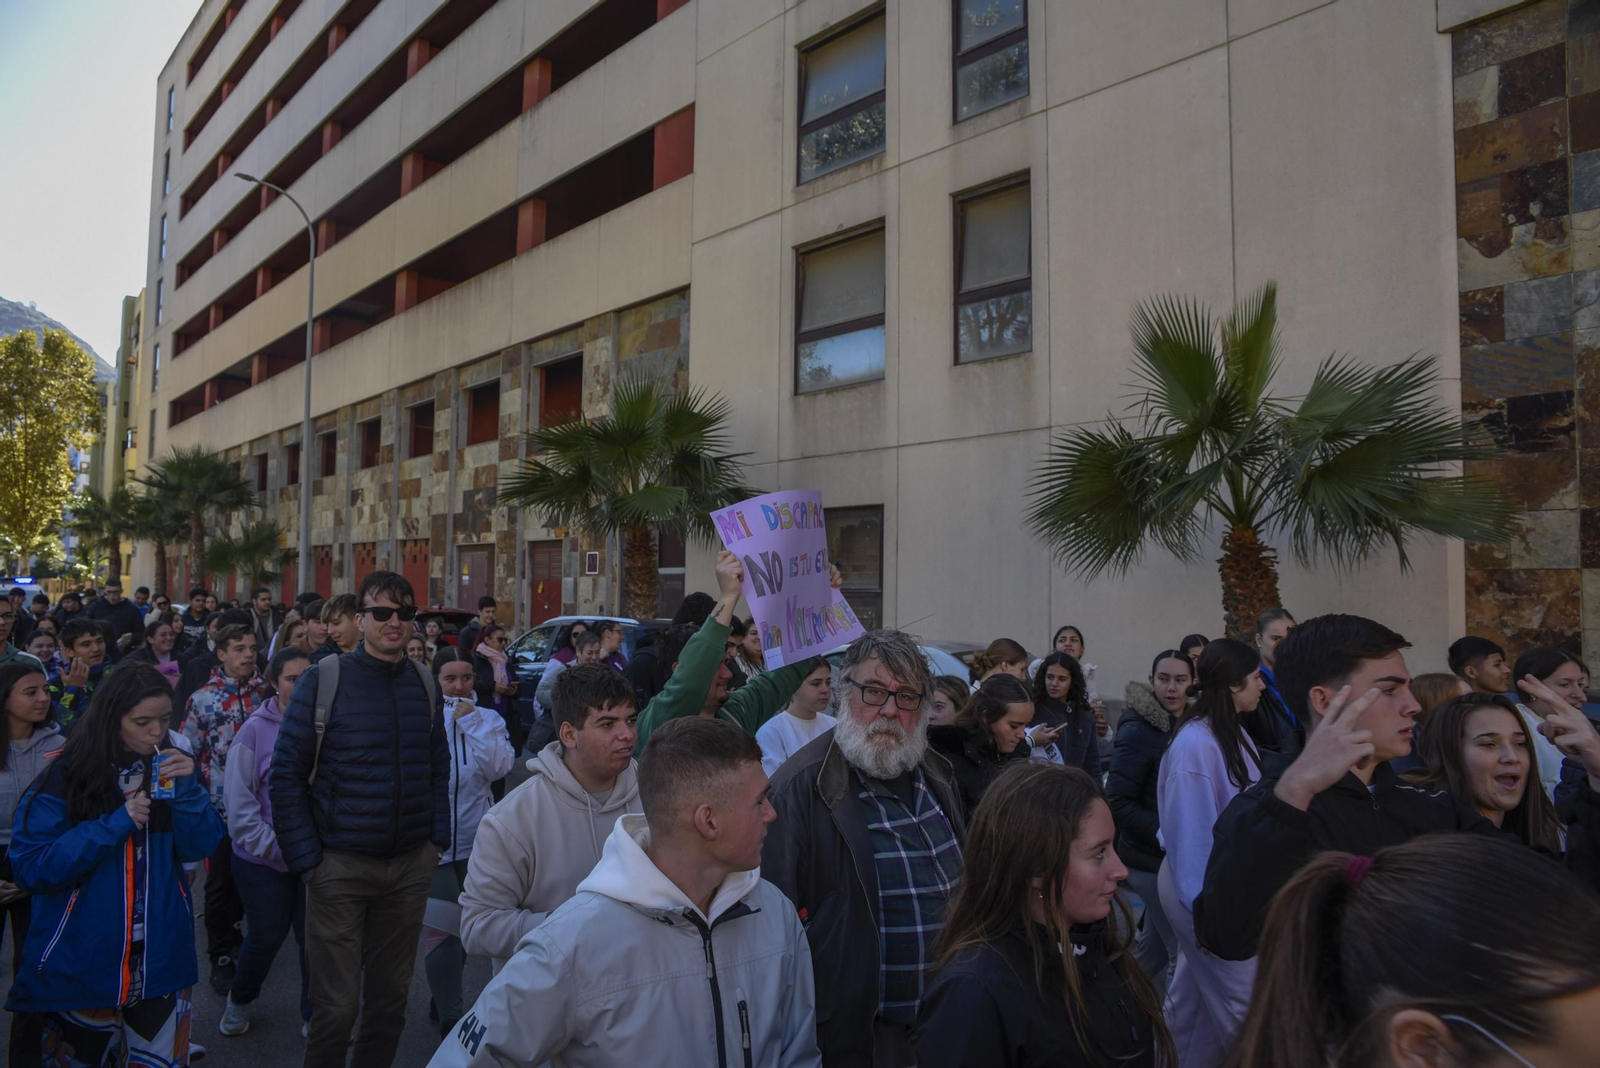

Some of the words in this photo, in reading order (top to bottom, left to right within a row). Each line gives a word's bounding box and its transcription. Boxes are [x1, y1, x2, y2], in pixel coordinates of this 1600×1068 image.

[743, 550, 783, 598] NO
[788, 557, 799, 579] ES
[800, 552, 812, 577] TU
[457, 1011, 488, 1058] HH
